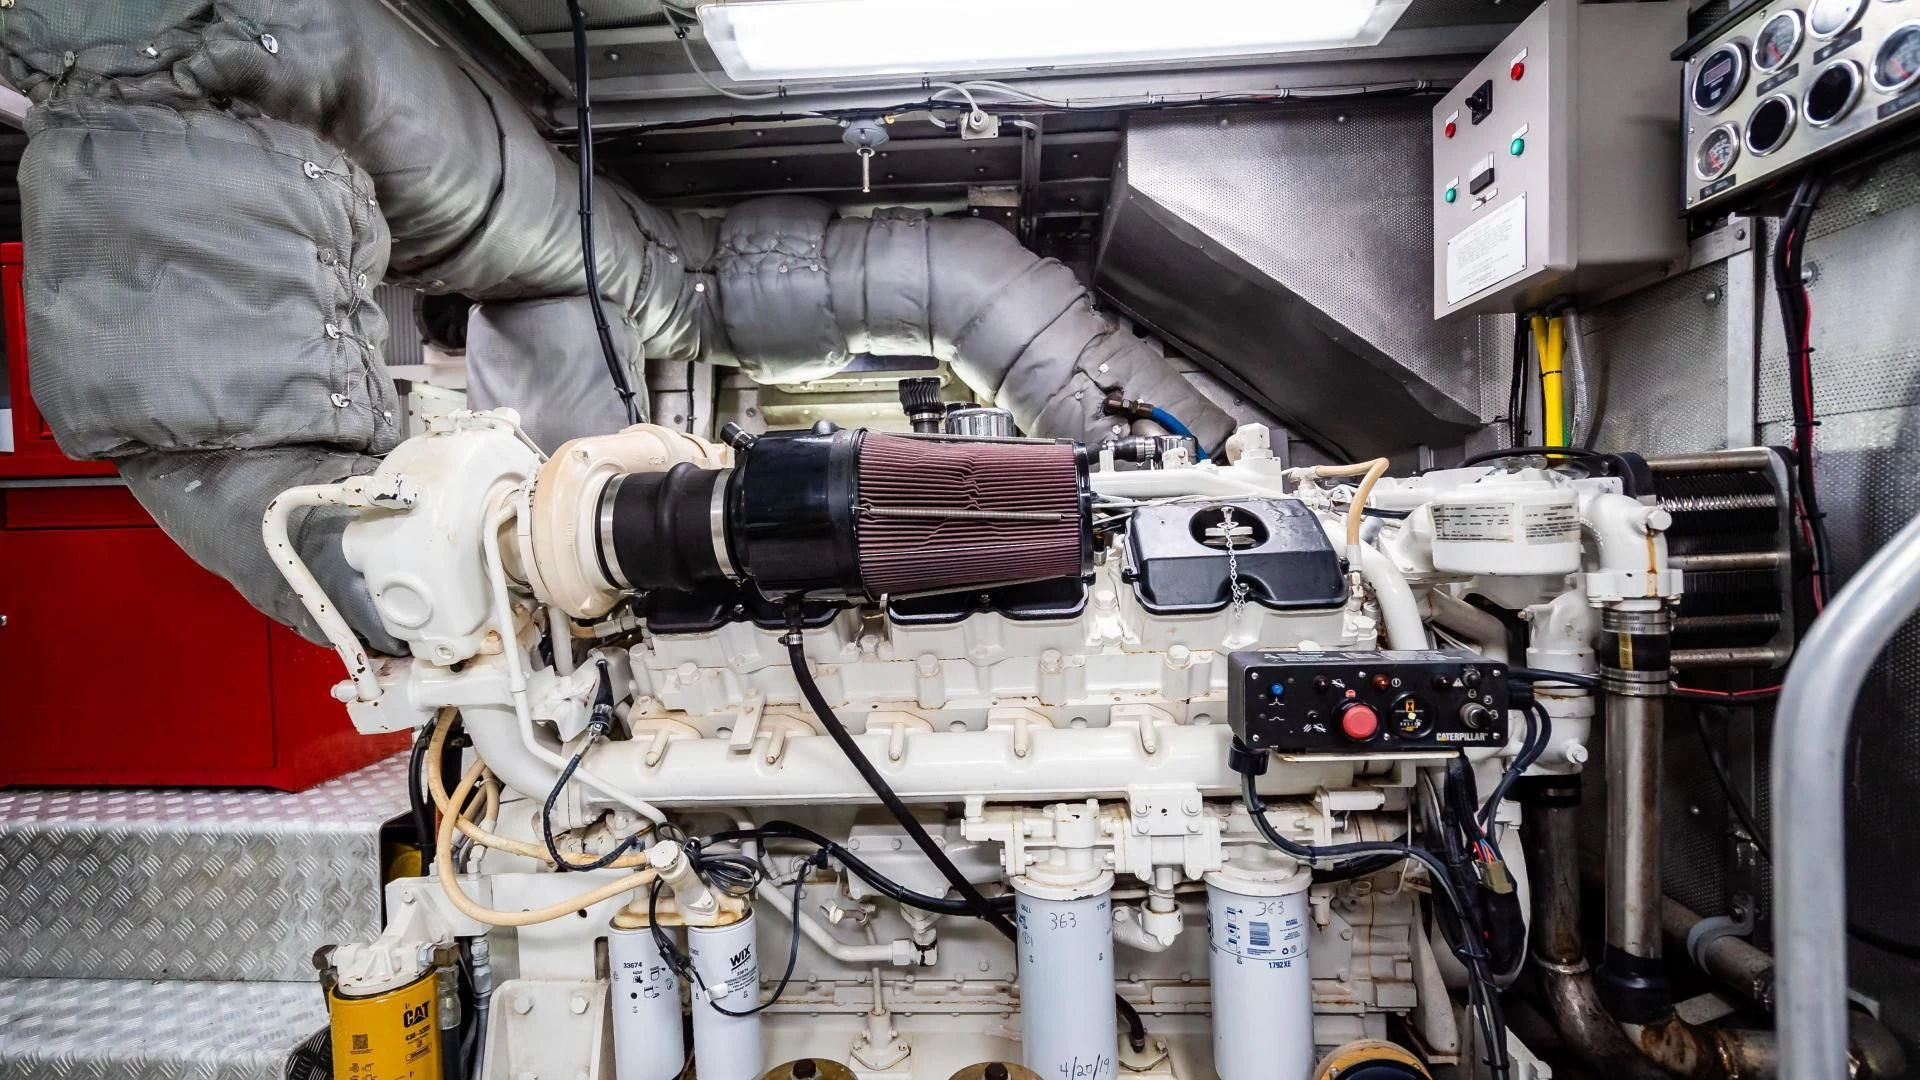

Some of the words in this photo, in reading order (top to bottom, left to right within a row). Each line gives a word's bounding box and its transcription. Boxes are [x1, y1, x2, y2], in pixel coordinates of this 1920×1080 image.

[1436, 732, 1486, 742] CATERPILLAR
[1256, 900, 1285, 917] 363
[1049, 912, 1077, 930] 363
[729, 943, 751, 967] WIX
[1268, 960, 1292, 969] 1792XE
[403, 1000, 431, 1028] CAT
[1060, 1053, 1110, 1080] 4/20/19
